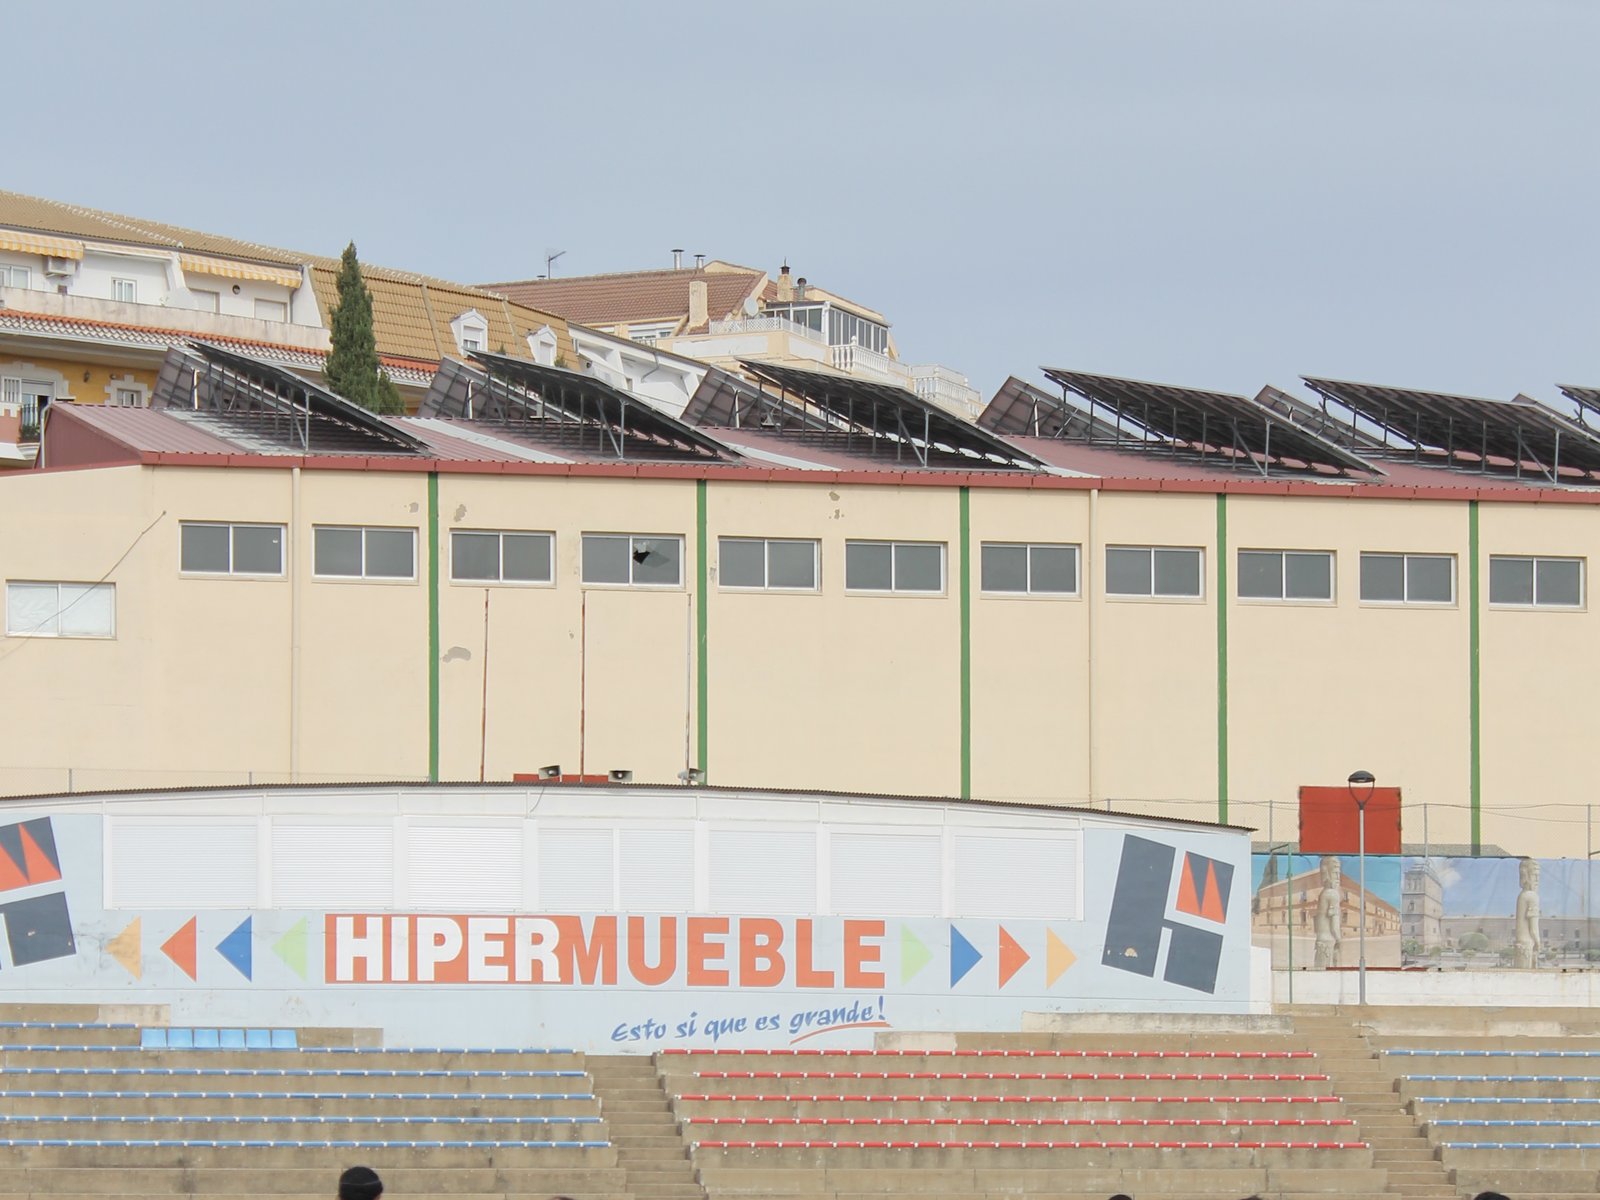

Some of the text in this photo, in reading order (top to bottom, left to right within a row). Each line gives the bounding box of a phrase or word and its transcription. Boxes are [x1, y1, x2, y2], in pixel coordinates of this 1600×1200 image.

[334, 914, 886, 988] HIPERMUEBLE
[611, 1018, 666, 1042] Esto
[704, 1016, 748, 1043] que
[754, 1013, 781, 1031] es
[789, 995, 887, 1034] grande!
